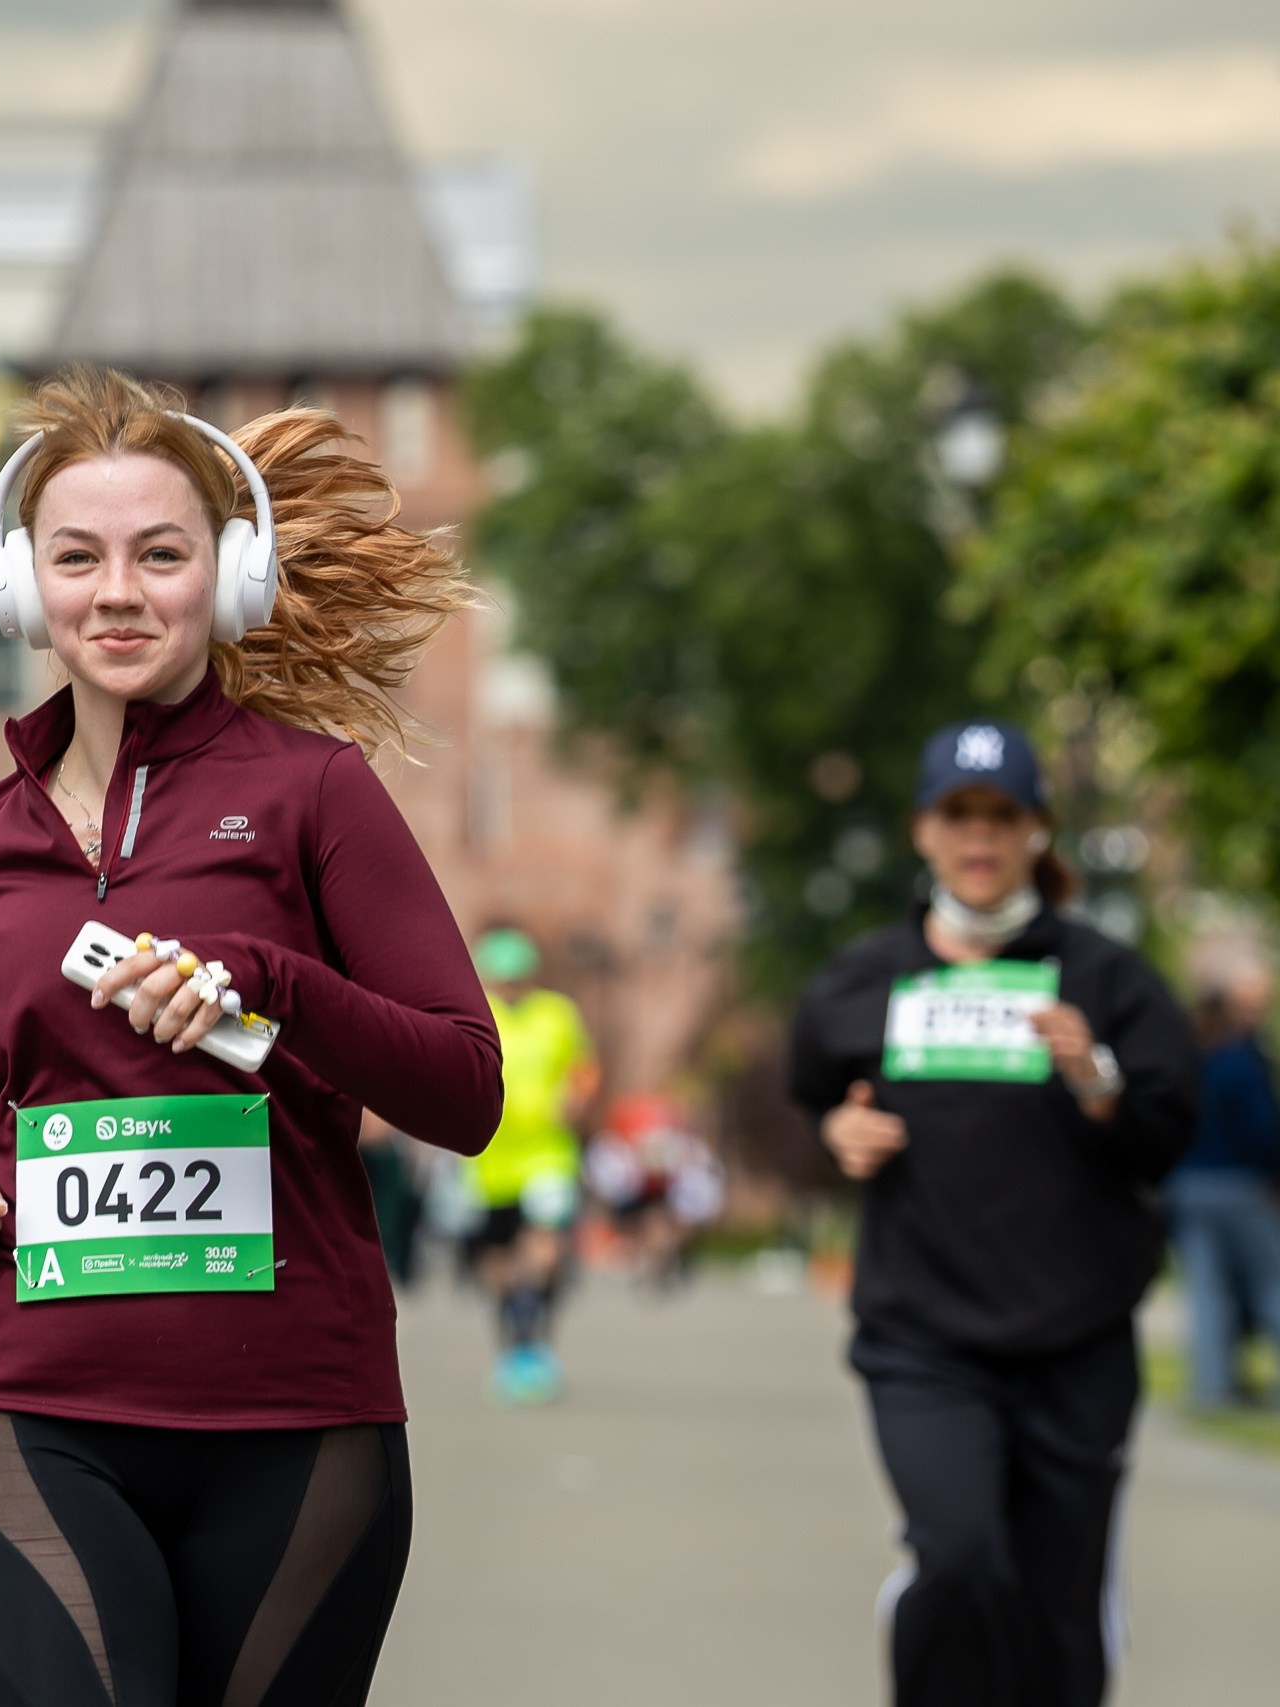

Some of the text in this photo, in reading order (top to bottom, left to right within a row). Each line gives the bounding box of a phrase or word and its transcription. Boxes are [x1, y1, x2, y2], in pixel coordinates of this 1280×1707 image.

[209, 829, 256, 843] Kalenji
[121, 1117, 173, 1138] Звук
[56, 1159, 223, 1227] 0422
[204, 1246, 238, 1260] 30.05
[37, 1247, 65, 1289] A
[205, 1260, 235, 1274] 2026
